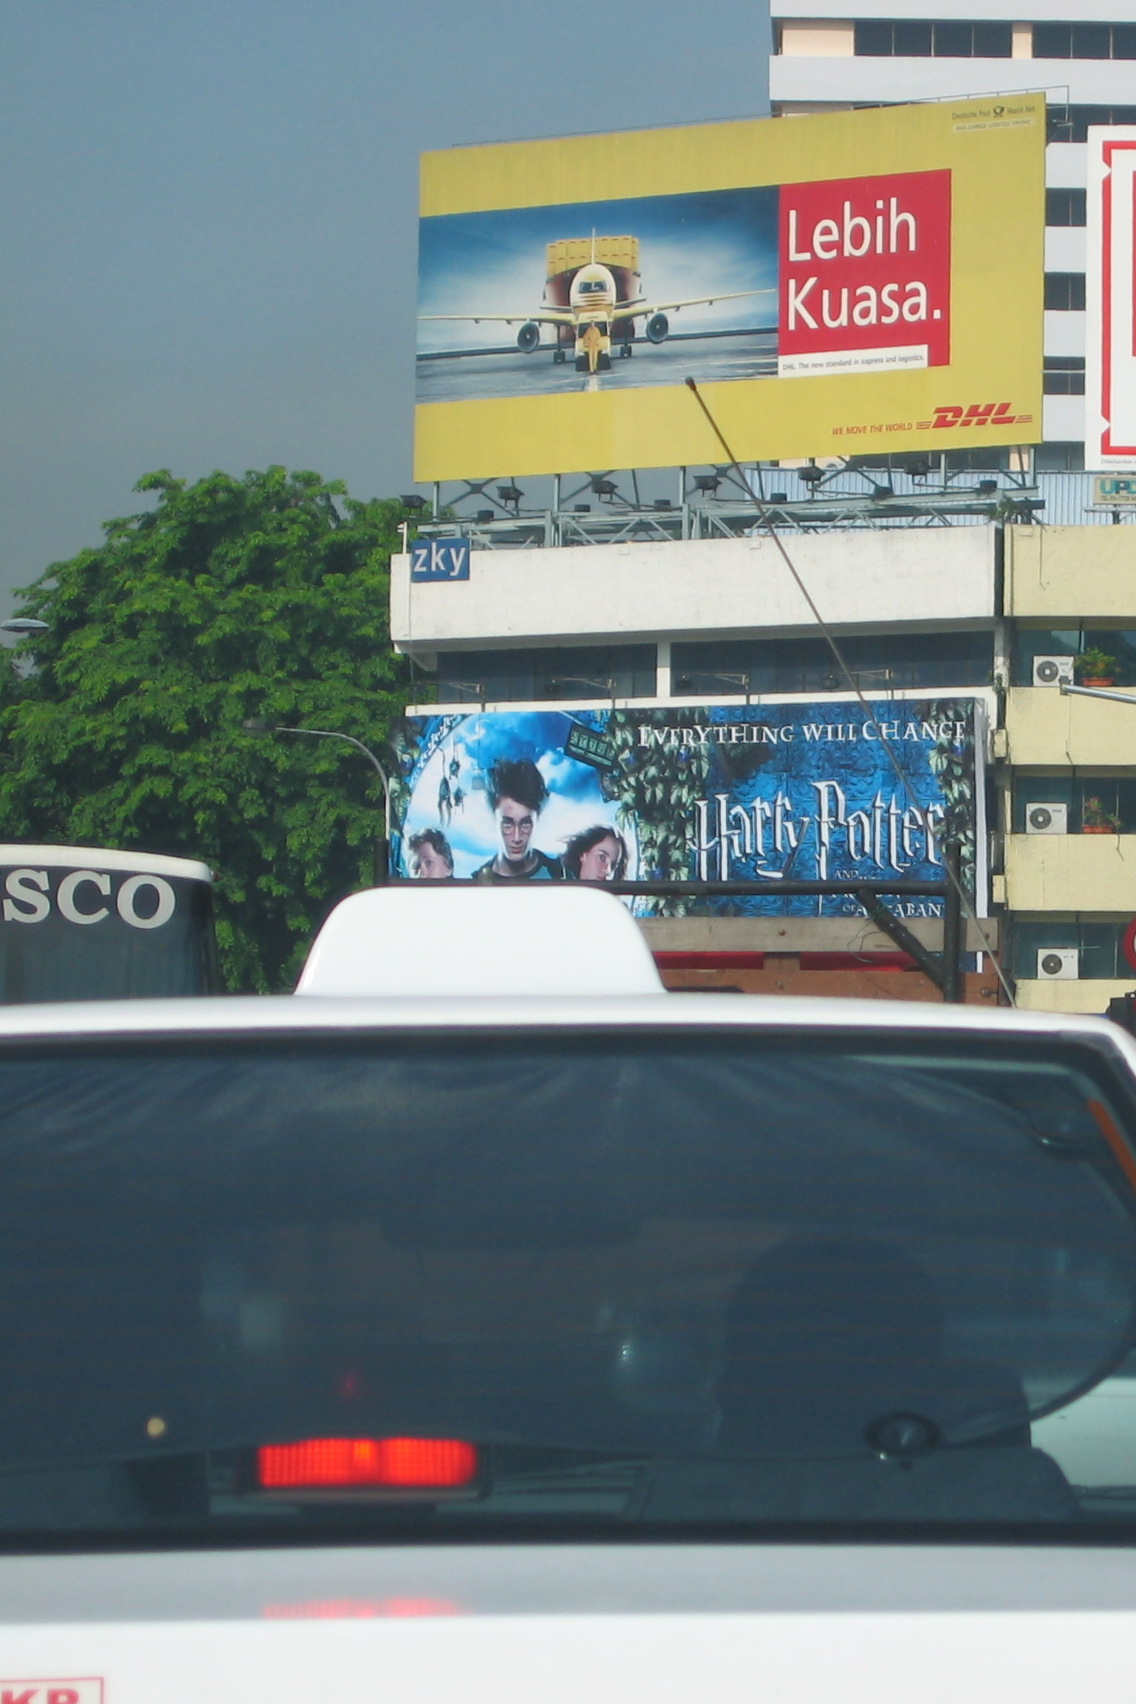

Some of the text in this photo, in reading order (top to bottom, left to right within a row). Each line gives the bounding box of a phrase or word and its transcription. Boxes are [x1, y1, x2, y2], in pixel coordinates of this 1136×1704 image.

[789, 197, 916, 262] Lebih
[788, 277, 941, 331] Kuasa.
[832, 422, 913, 435] WE MOVE THE WORLD
[931, 402, 1017, 429] DHL
[414, 541, 466, 577] zky
[638, 723, 794, 748] EVERYTHING
[801, 723, 857, 743] WILL
[862, 719, 966, 742] CHANGE
[3, 868, 175, 929] SCO
[854, 902, 942, 918] AABAN
